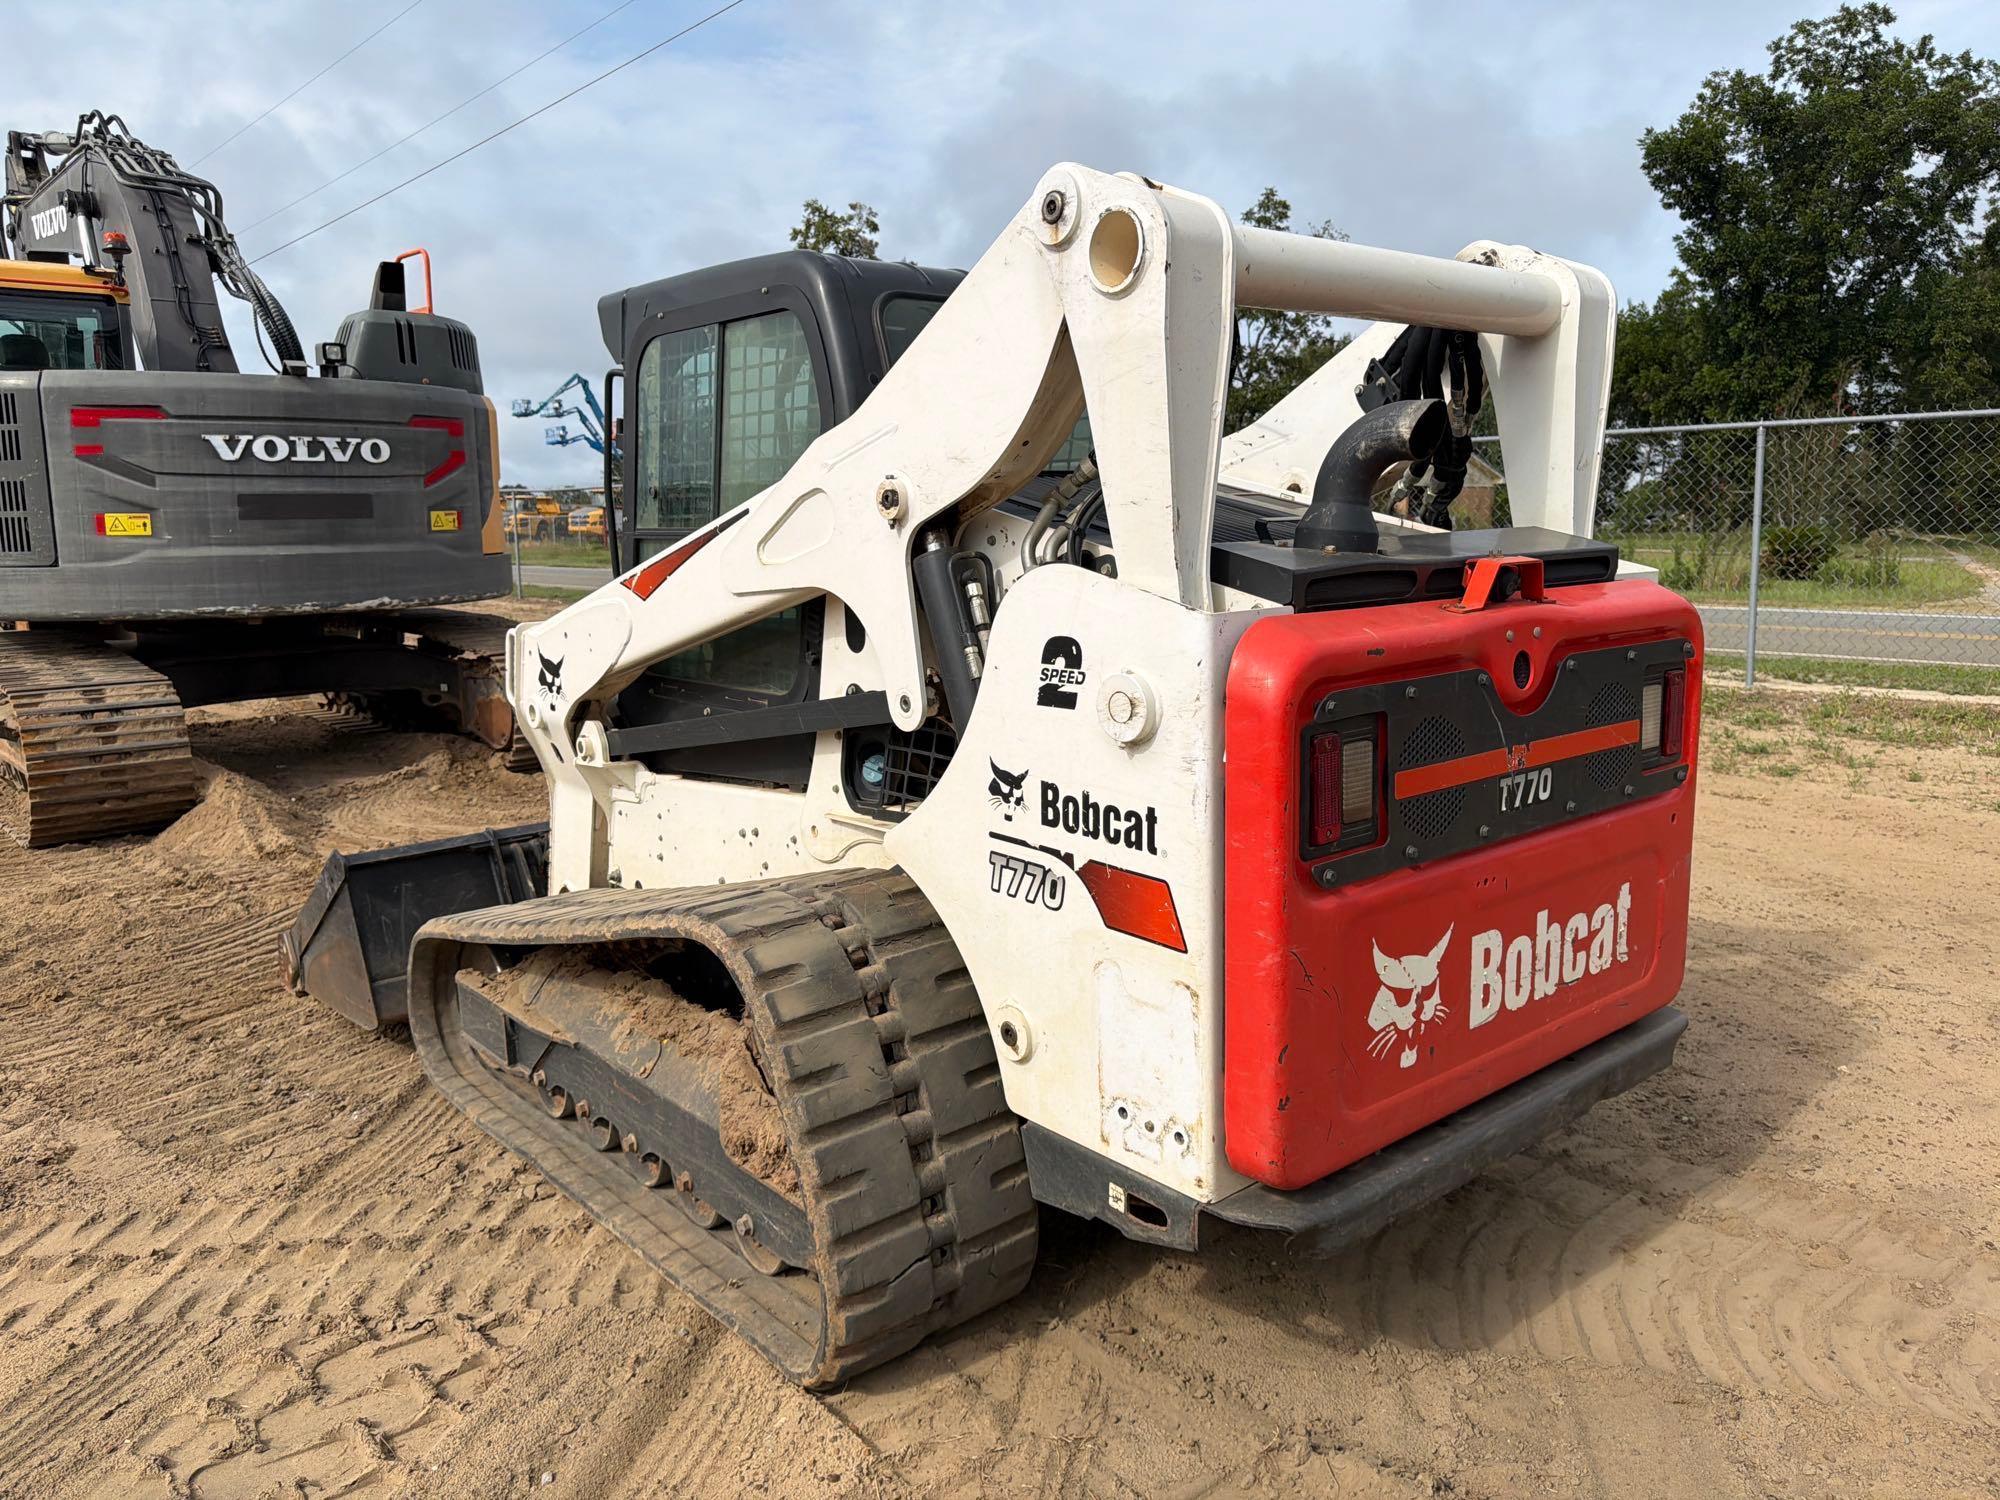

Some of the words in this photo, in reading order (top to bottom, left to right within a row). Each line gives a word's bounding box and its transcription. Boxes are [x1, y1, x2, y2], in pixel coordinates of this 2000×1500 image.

[31, 205, 67, 240] VOLVO
[201, 434, 391, 464] VOLVO
[1040, 668, 1086, 685] SPEED
[1500, 767, 1552, 811] T770
[1040, 780, 1158, 856] Bobcat
[989, 850, 1065, 911] T770
[1469, 881, 1631, 1030] Bobcat
